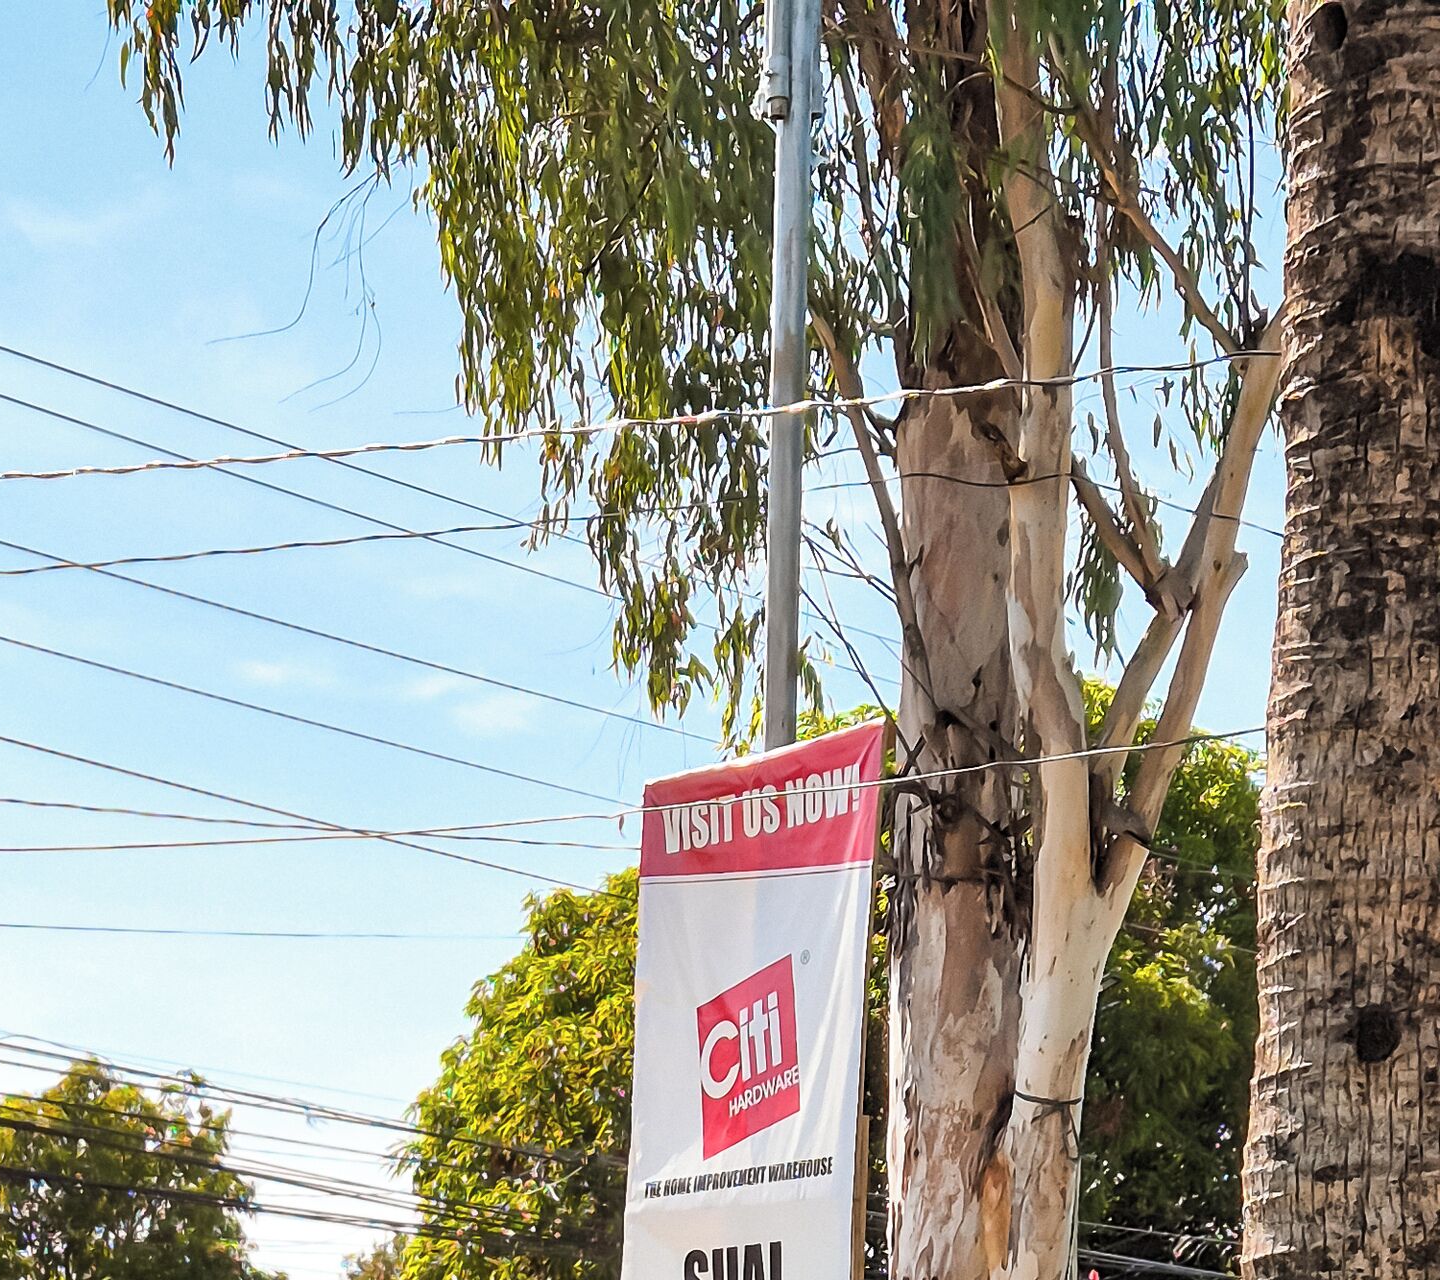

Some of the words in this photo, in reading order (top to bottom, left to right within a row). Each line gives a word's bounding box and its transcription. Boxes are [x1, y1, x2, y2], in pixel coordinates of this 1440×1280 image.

[662, 794, 736, 855] VISIT
[742, 784, 781, 838] US
[785, 763, 861, 828] NOW!
[728, 1065, 800, 1118] HARDWARE
[644, 1180, 662, 1199] THE
[663, 1176, 692, 1196] HOME
[693, 1165, 767, 1191] IMPROVEMENT
[768, 1156, 833, 1183] WAREHOUSE
